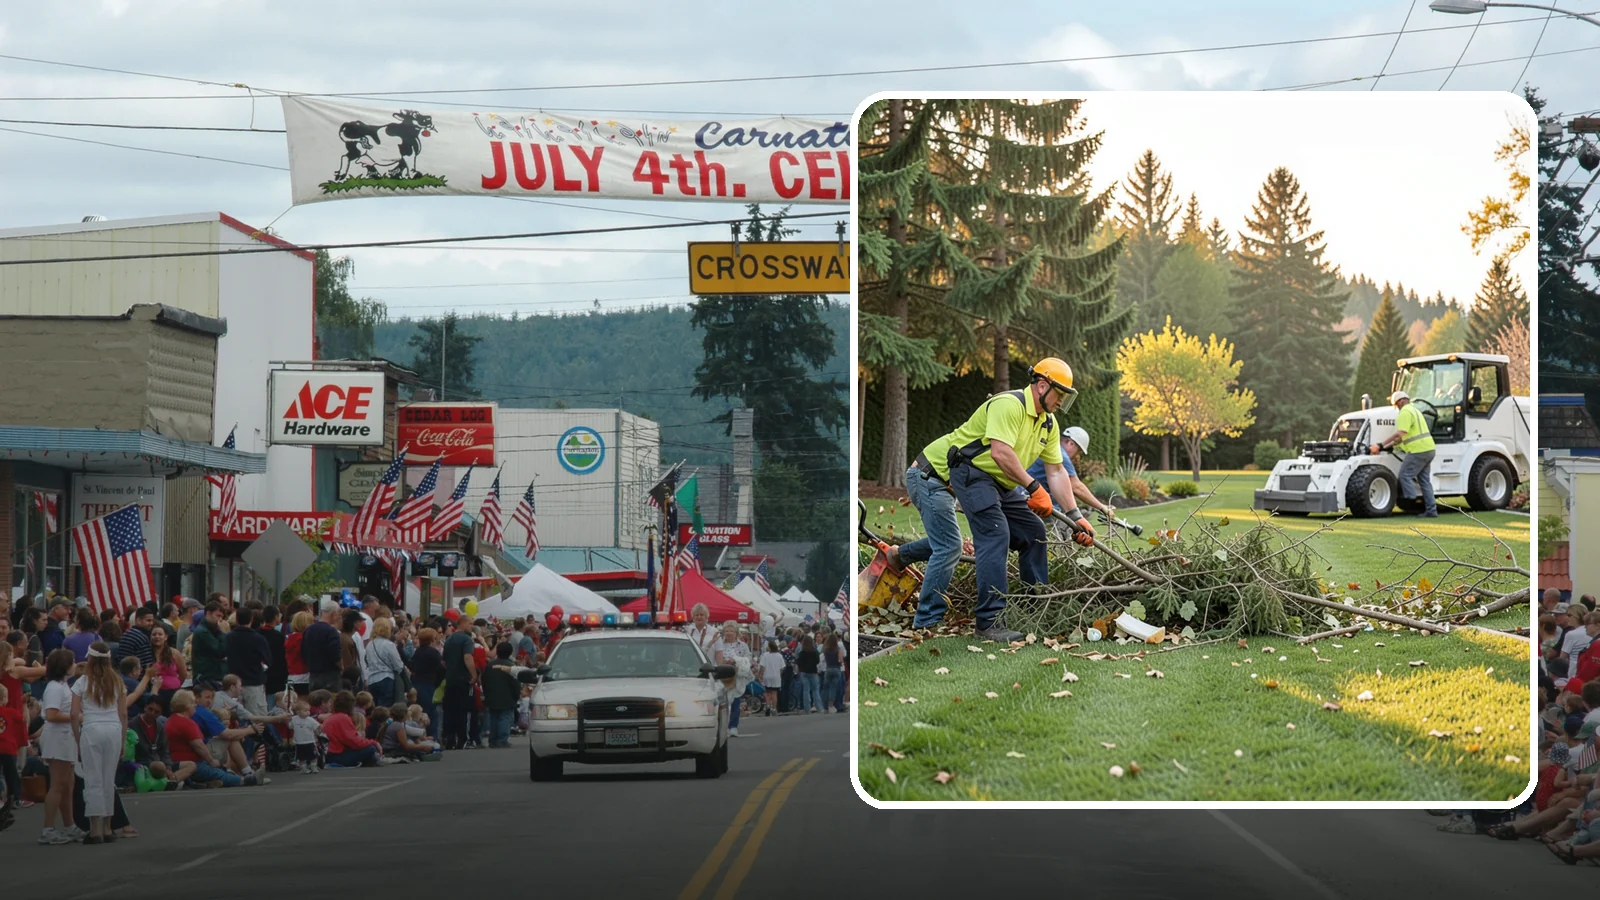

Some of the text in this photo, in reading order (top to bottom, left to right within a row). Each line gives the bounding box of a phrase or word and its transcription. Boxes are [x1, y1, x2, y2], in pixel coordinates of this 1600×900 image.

[694, 121, 850, 150] Carnat
[481, 140, 605, 192] JULY
[632, 150, 747, 198] 4th.
[696, 254, 850, 280] CROSSWA
[282, 379, 374, 420] ACE
[405, 408, 486, 422] CEDAR LOG
[283, 421, 371, 437] Hardware
[95, 485, 124, 495] Vincent
[126, 486, 136, 495] de
[138, 486, 155, 496] Paul
[688, 526, 742, 535] CRNATION
[698, 535, 730, 543] GLASS
